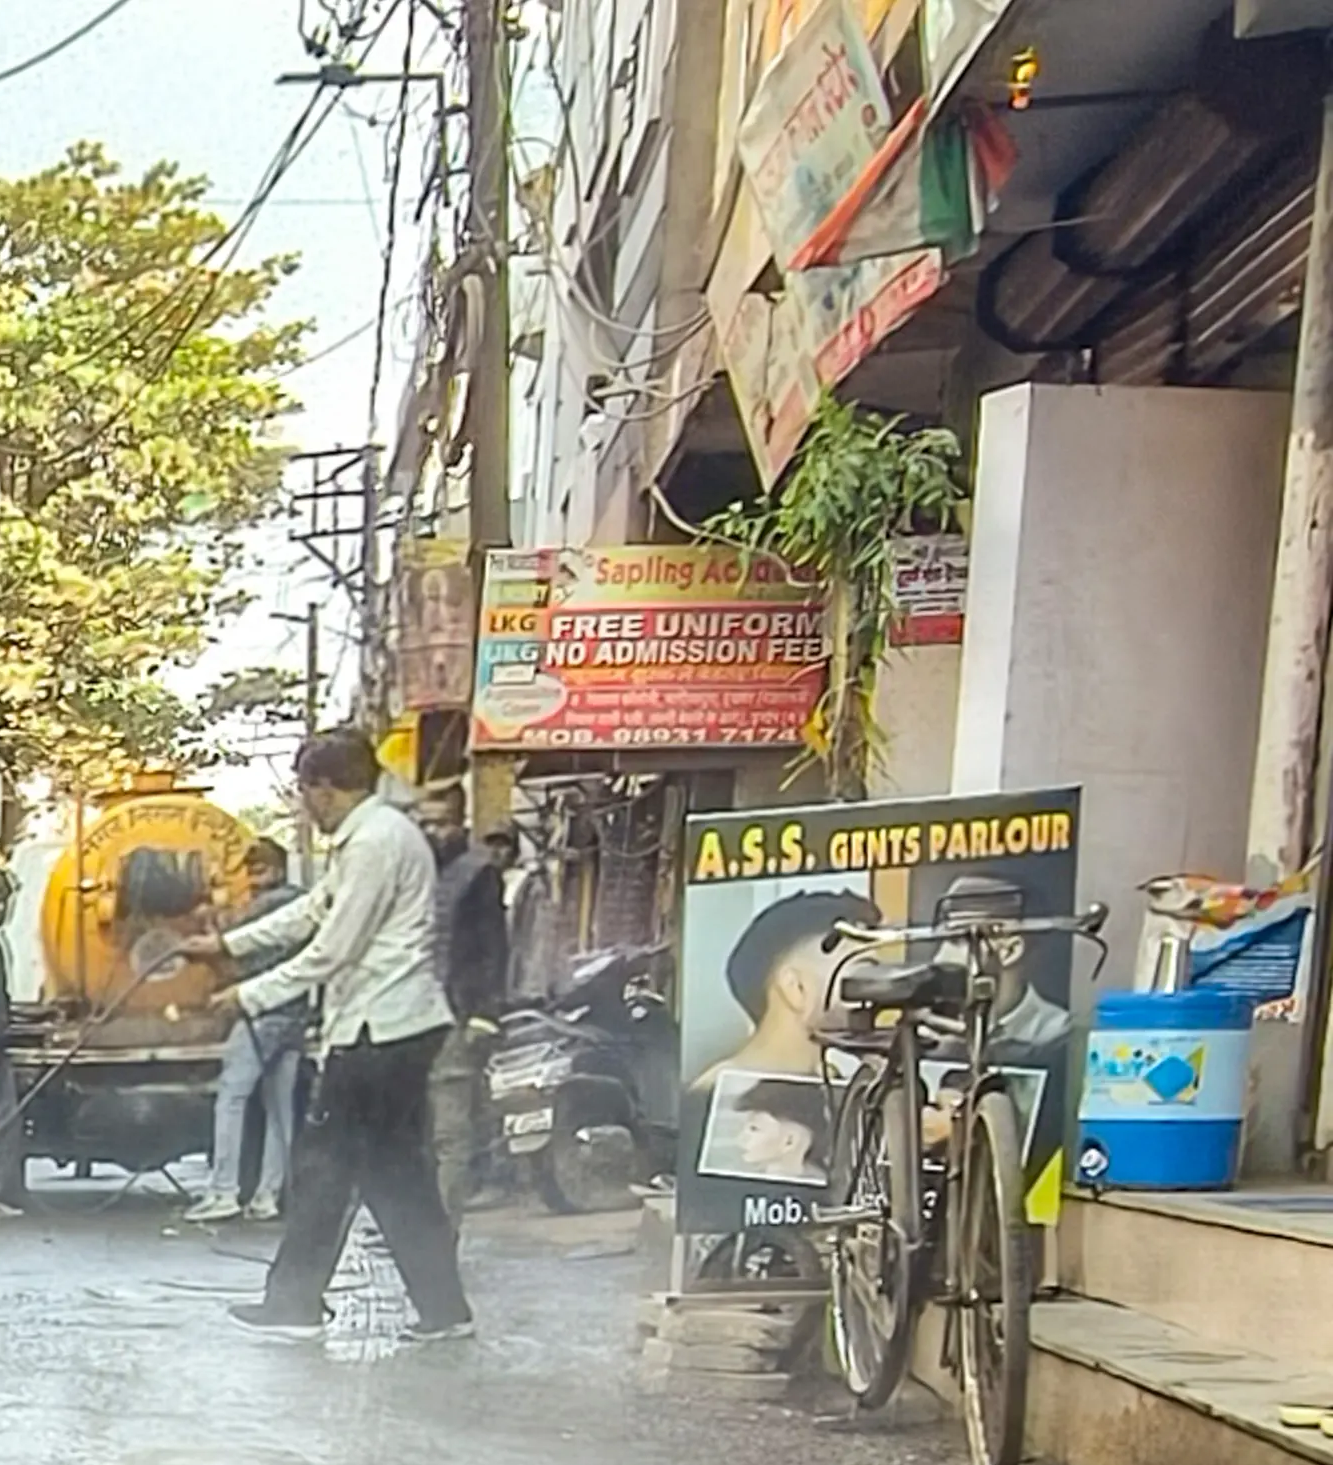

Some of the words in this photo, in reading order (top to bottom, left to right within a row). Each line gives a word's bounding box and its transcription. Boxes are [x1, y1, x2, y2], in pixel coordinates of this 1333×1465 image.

[594, 556, 694, 590] Sapling
[489, 613, 538, 633] LKG
[550, 613, 645, 640] FREE
[655, 611, 822, 639] UNIFORM
[545, 642, 586, 666] NO
[594, 639, 762, 665] ADMISSION
[694, 821, 817, 881] A.S.S.
[828, 823, 923, 869] GENTS
[927, 810, 1072, 864] PARLOUR
[744, 1196, 810, 1227] Mob.
